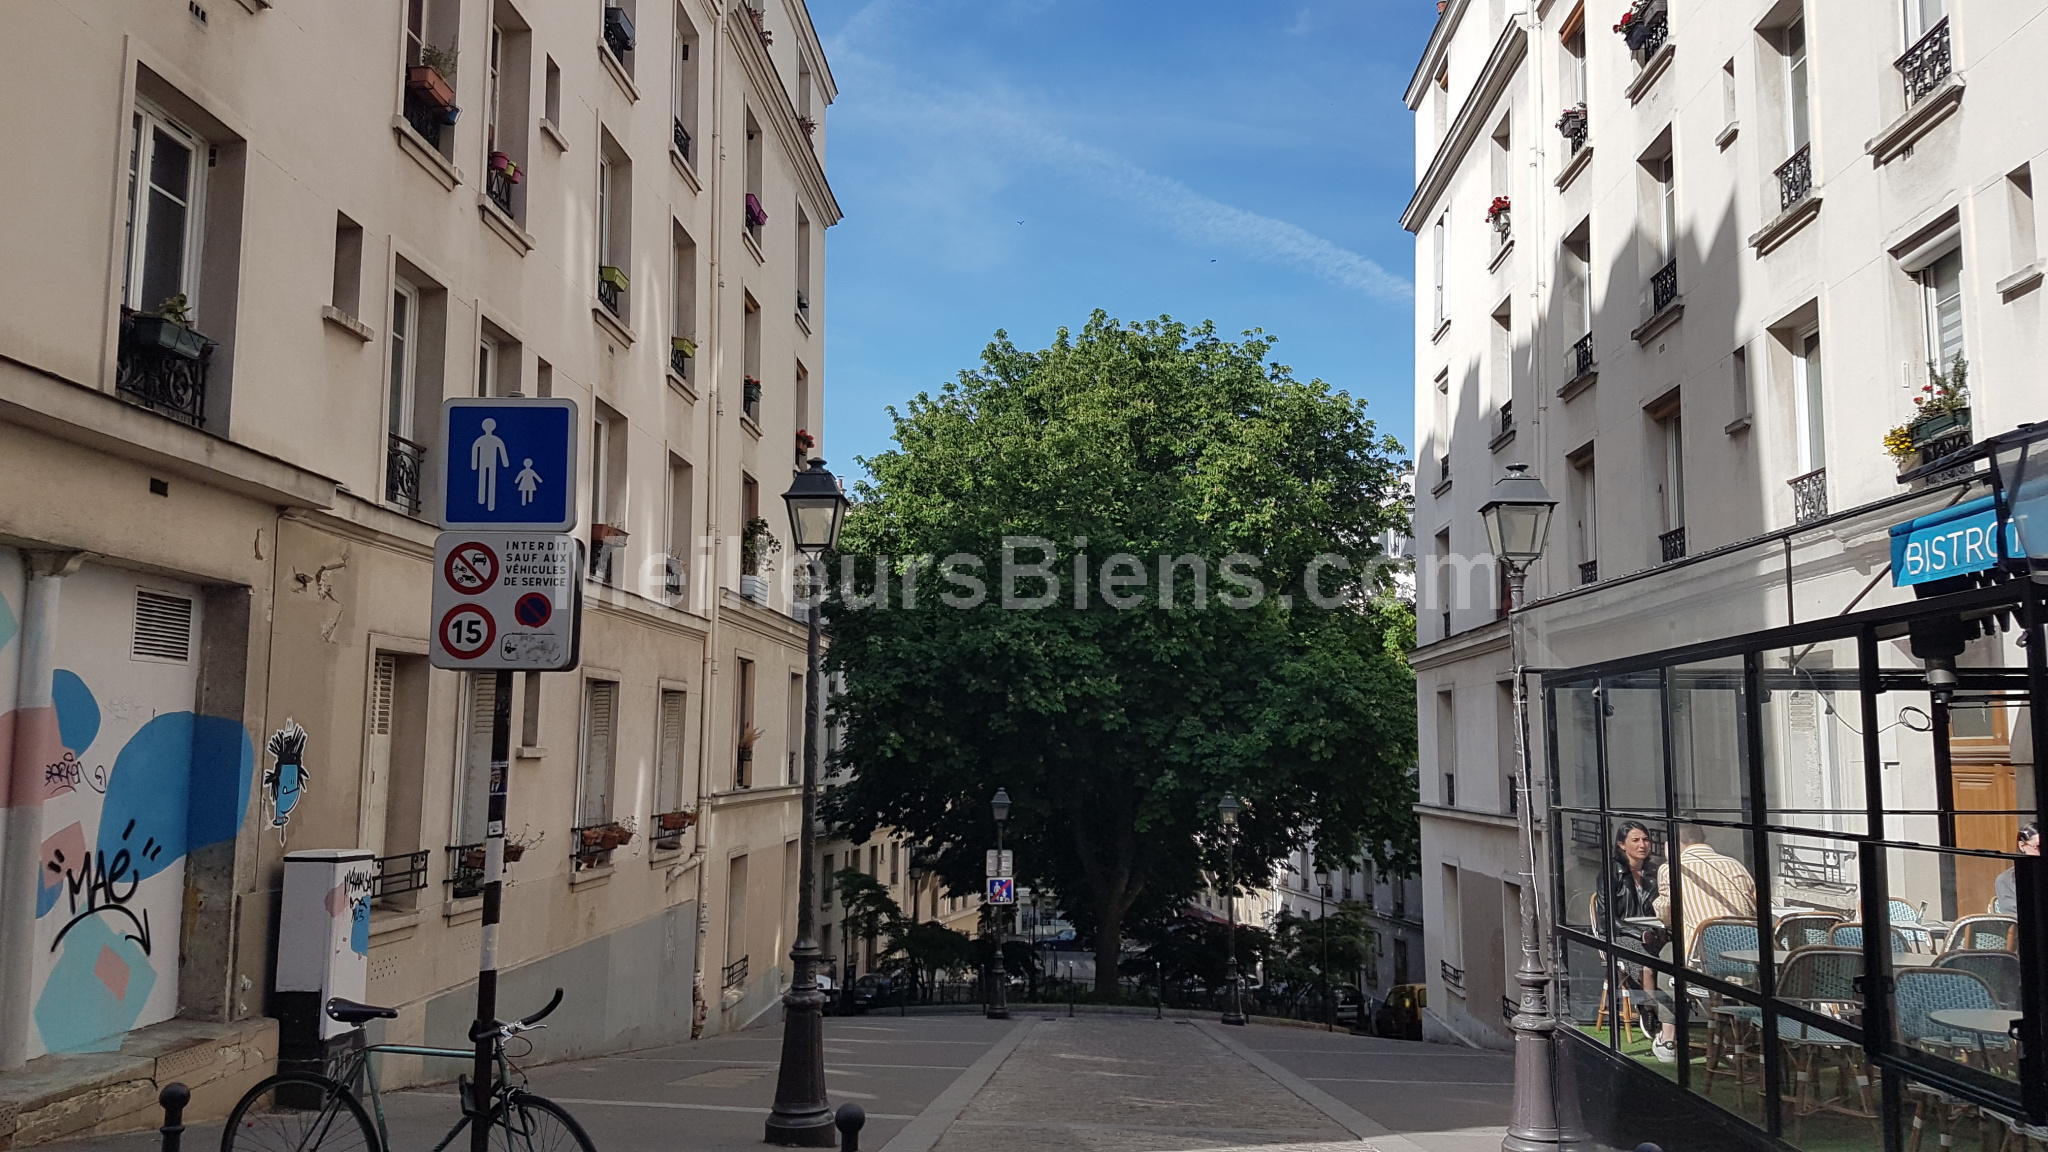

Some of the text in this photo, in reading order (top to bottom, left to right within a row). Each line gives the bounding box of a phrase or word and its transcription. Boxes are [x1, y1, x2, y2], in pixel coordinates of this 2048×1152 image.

[505, 540, 568, 551] INTERDIT
[506, 553, 567, 563] SAUF AUX
[505, 563, 566, 575] VÉHICULES
[503, 577, 566, 587] DE SERVICE
[452, 619, 482, 644] 15
